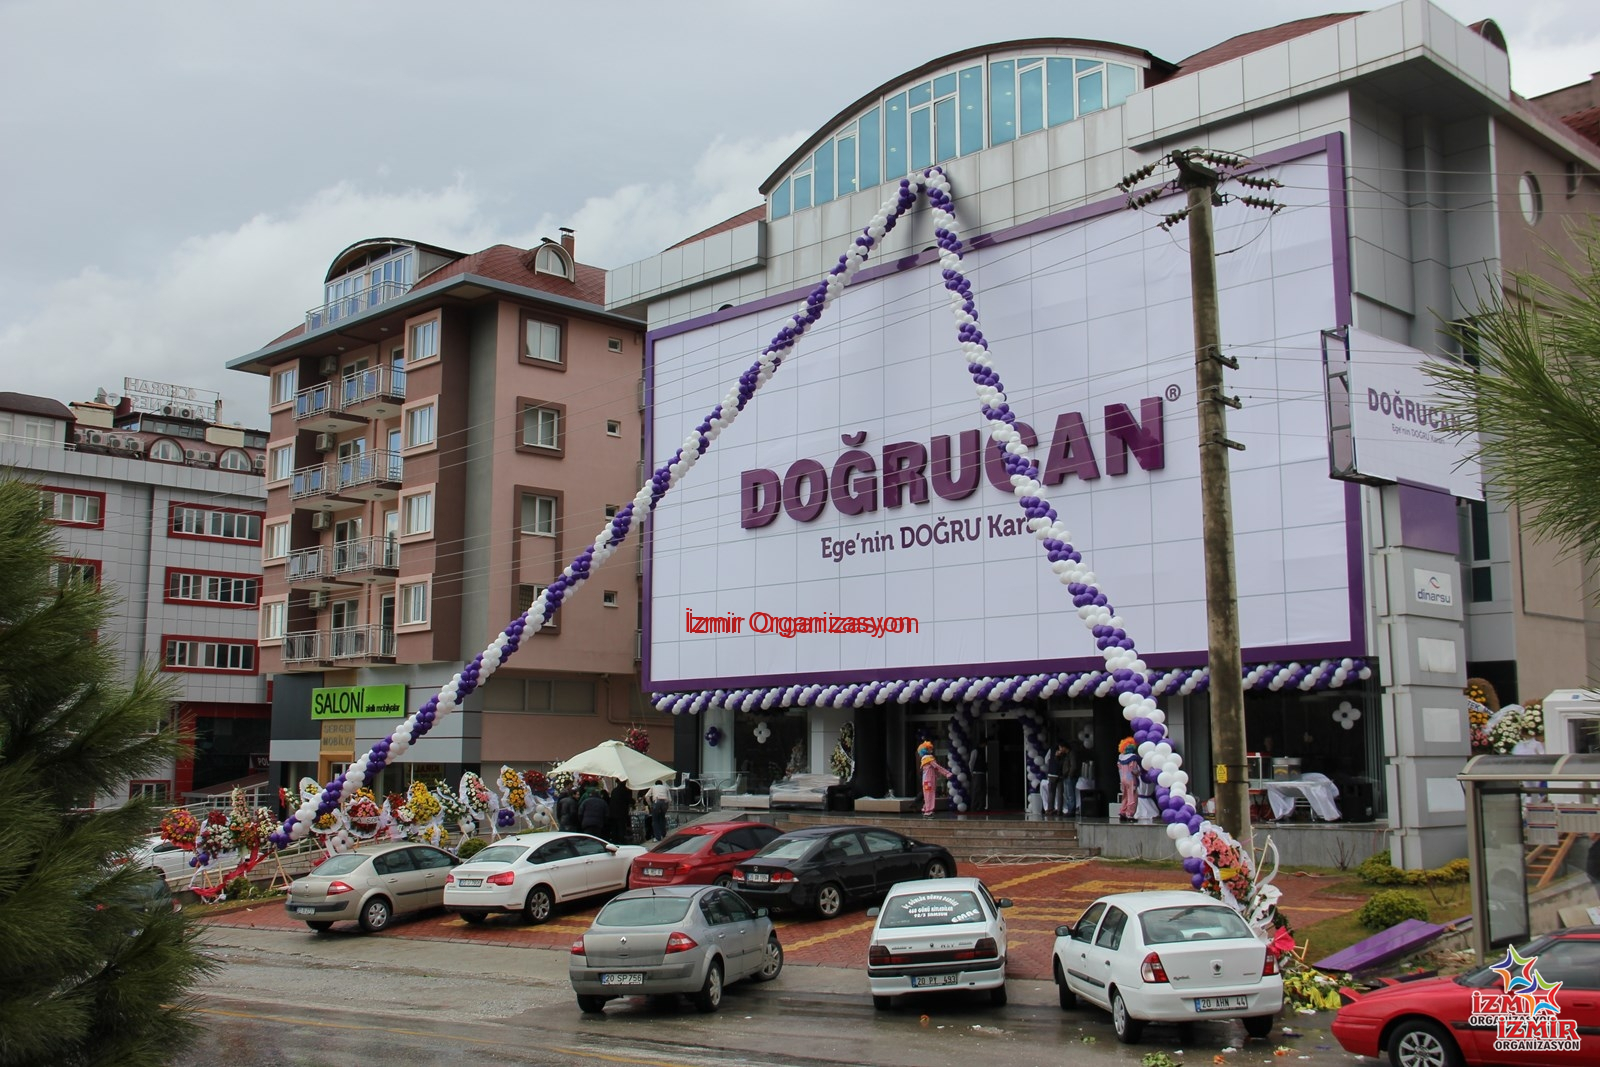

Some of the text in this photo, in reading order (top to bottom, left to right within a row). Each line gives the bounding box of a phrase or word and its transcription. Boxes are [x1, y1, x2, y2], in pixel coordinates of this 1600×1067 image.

[740, 396, 1164, 528] DOĞRUCAN
[900, 516, 981, 549] DOĞRU
[1417, 588, 1451, 603] dinarsu
[944, 976, 956, 984] 493
[1202, 997, 1246, 1008] 20 AHN 44
